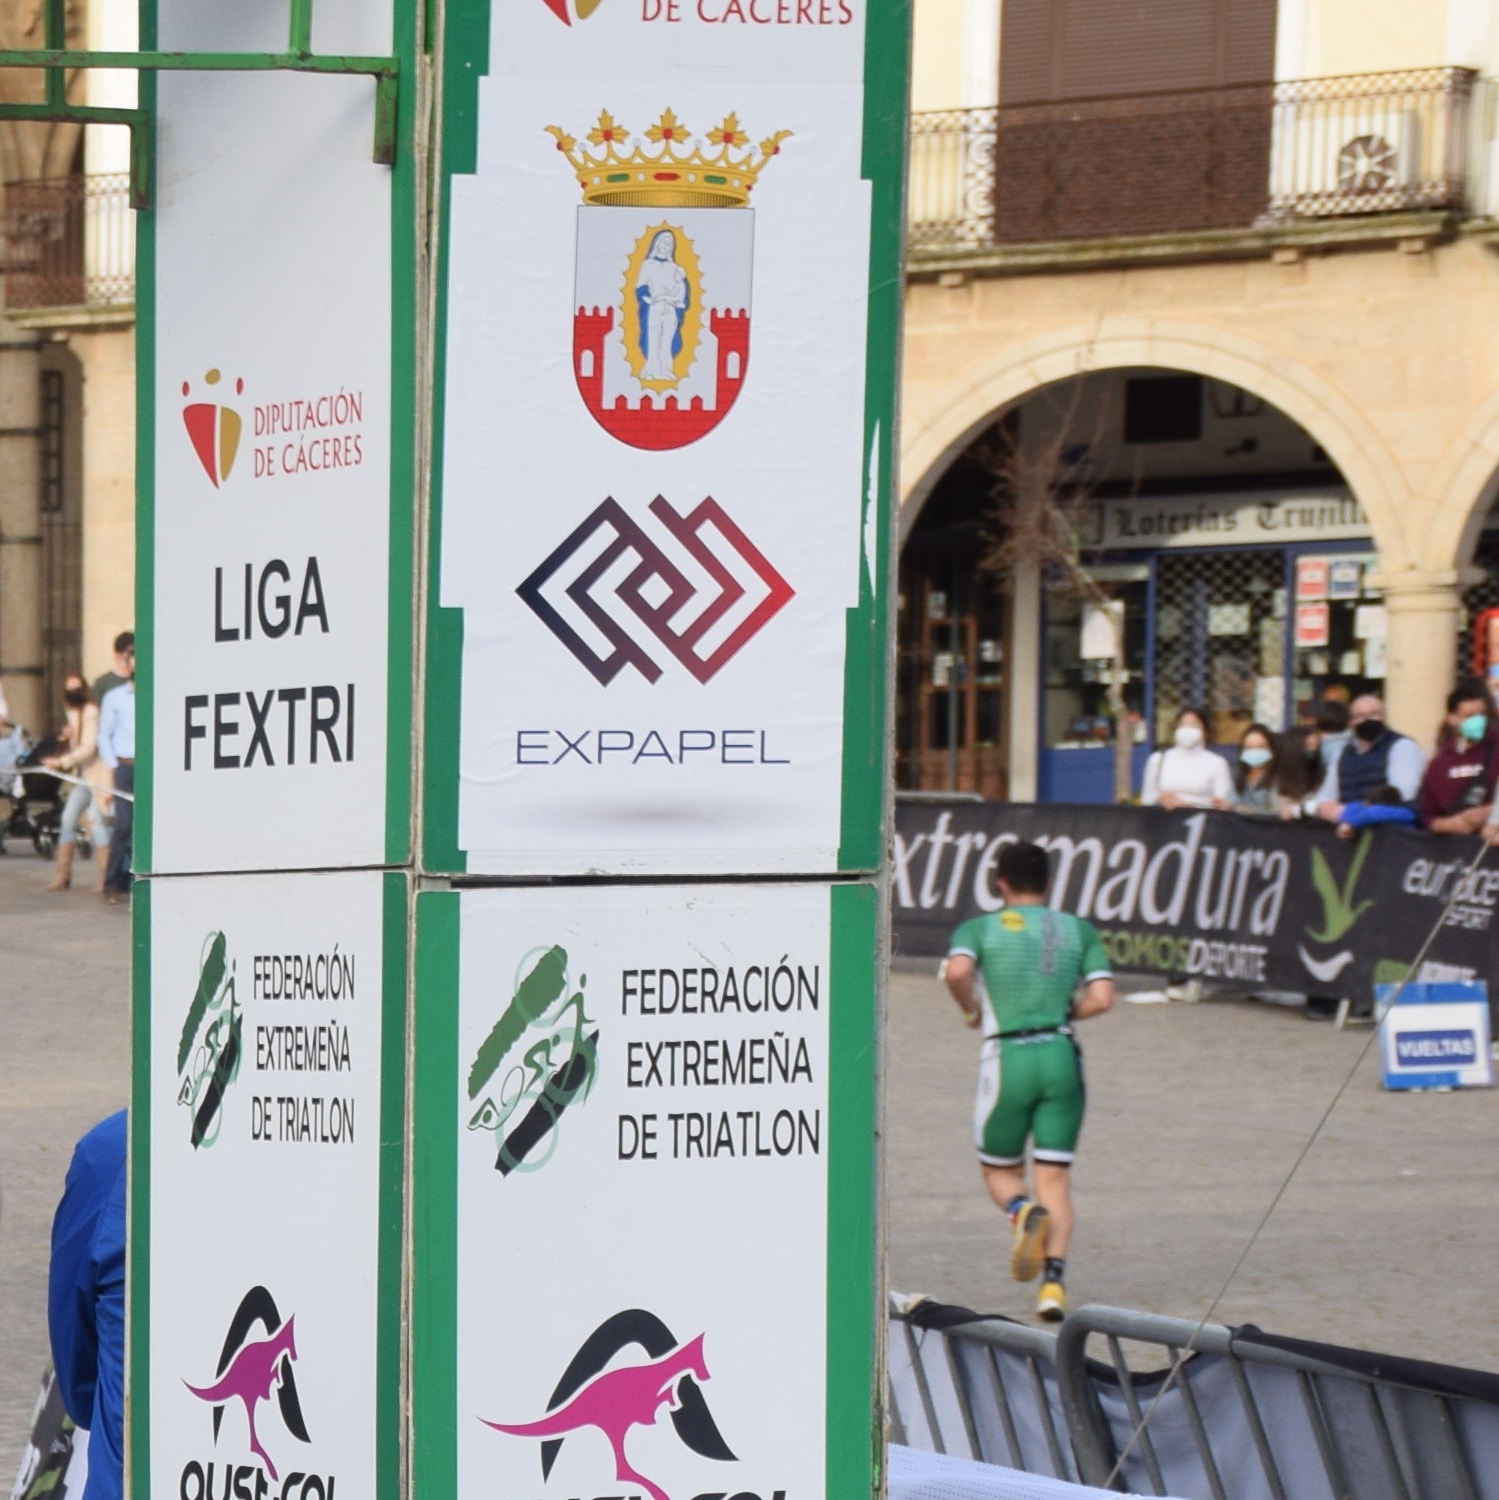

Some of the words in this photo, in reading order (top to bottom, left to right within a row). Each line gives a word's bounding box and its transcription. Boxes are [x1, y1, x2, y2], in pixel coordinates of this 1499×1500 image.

[253, 386, 363, 437] DIPUTACIÓN
[253, 448, 275, 478] DE
[281, 433, 363, 475] CÁCERES
[214, 556, 330, 643] LIGA
[183, 683, 356, 771] FEXTRI
[515, 730, 791, 765] EXPAPEL
[893, 810, 1293, 937] xtremadura
[253, 942, 355, 1001] FEDERACIÓN
[621, 953, 820, 1015] FEDERACIÓN
[256, 1019, 352, 1072] EXTREMEÑA
[626, 1031, 814, 1089] EXTREMEÑA
[1398, 1034, 1476, 1060] VUELTAS
[252, 1096, 272, 1141] DE
[276, 1097, 355, 1144] TRIATLON
[617, 1113, 658, 1161] DE
[666, 1109, 820, 1158] TRIATLON
